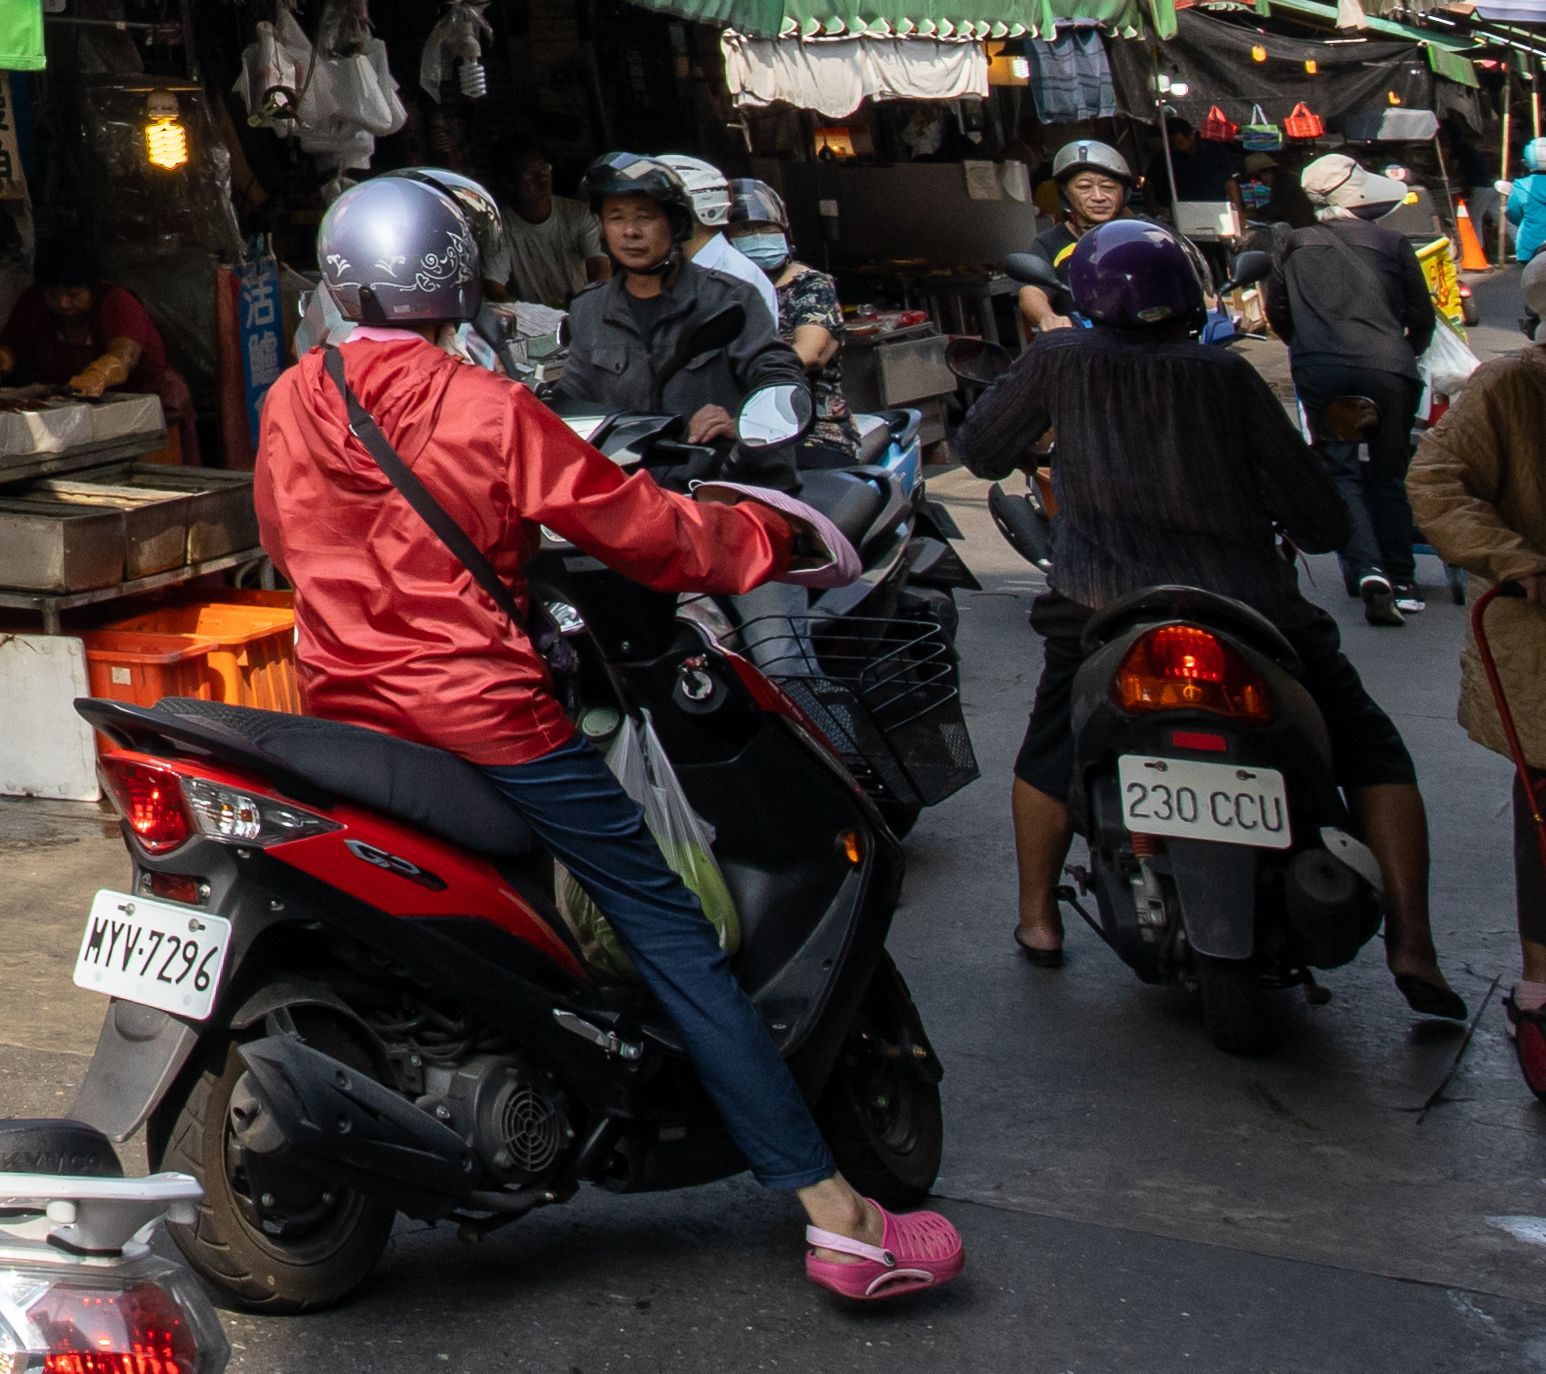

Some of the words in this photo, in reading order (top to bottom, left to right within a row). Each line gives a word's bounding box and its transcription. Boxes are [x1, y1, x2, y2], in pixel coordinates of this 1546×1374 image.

[1126, 781, 1198, 823] 230
[1210, 791, 1283, 832] CCU
[83, 914, 220, 994] MYV-7296
